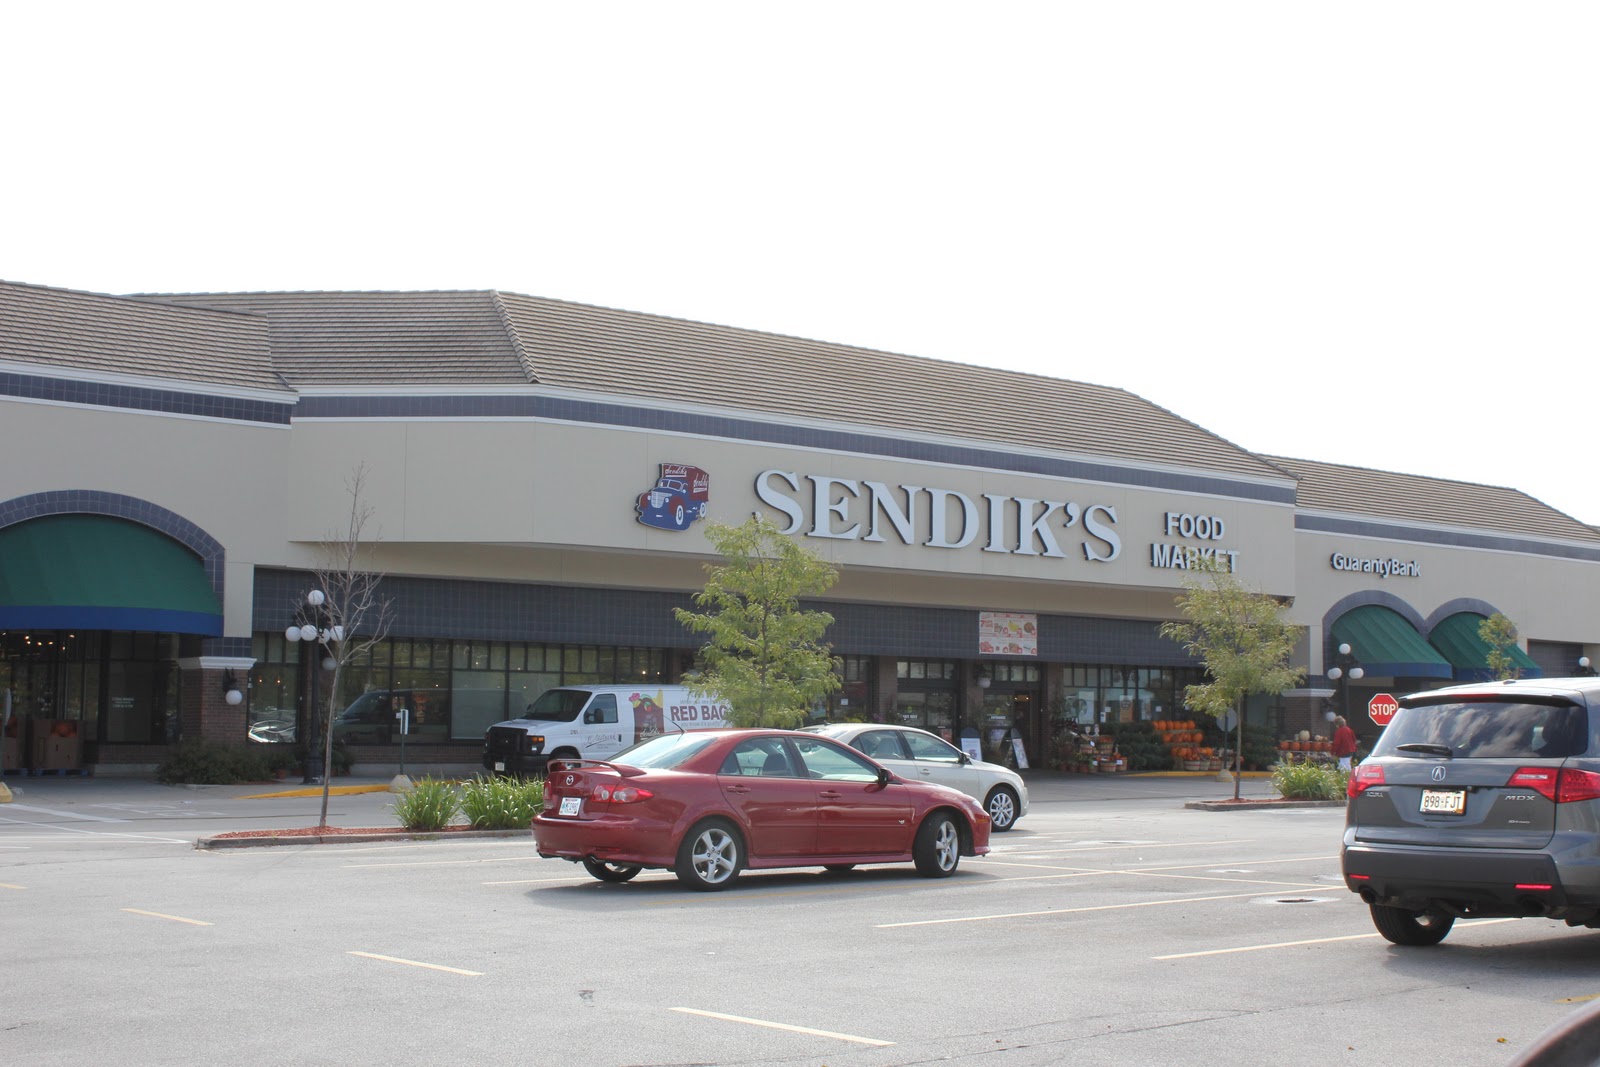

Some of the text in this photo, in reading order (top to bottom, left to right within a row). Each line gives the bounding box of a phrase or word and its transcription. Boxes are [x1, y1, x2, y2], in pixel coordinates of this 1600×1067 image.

[752, 469, 1122, 562] SENDIK'S
[1164, 512, 1225, 540] FOOD
[1150, 543, 1240, 573] MARKET
[670, 706, 697, 721] RED
[1371, 704, 1396, 716] STOP
